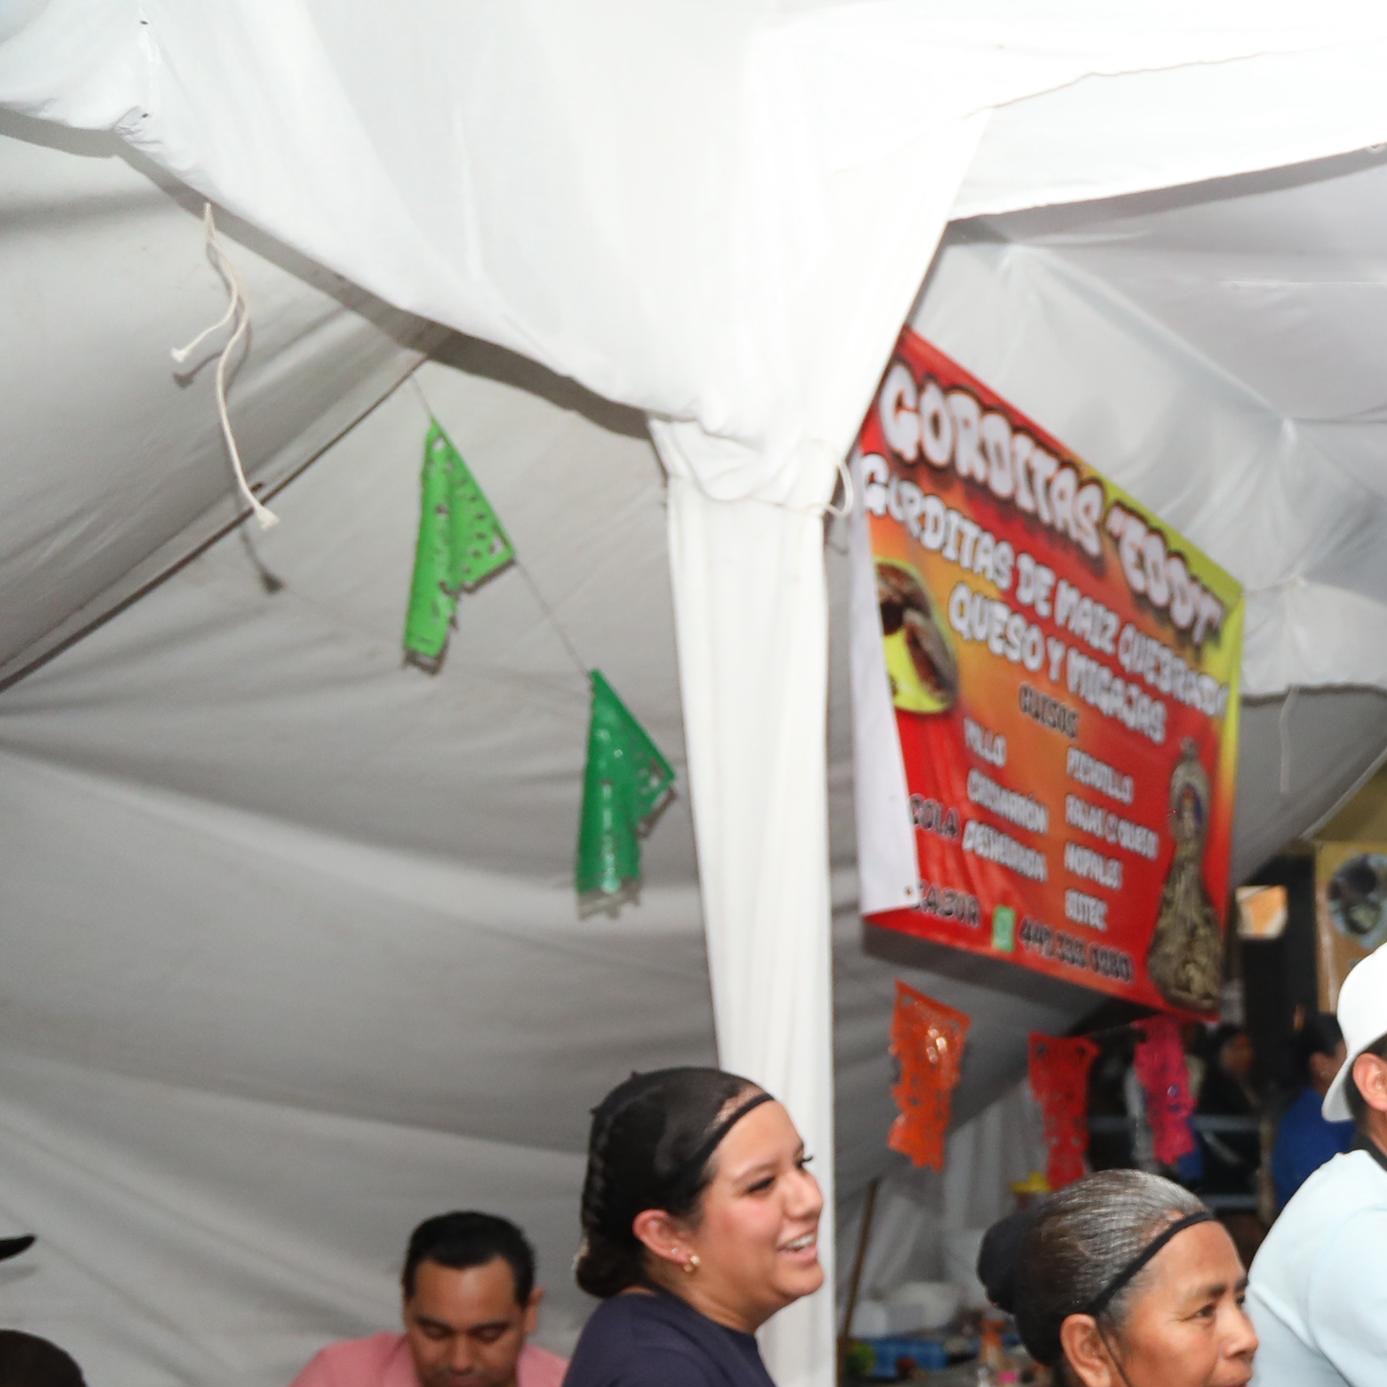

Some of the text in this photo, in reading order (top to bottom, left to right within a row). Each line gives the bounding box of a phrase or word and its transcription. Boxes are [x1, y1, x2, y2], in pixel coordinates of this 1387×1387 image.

[879, 364, 1104, 557] GORDITAS
[949, 582, 1167, 745] QUESO Y MIGAJAS
[1016, 552, 1056, 618] DE
